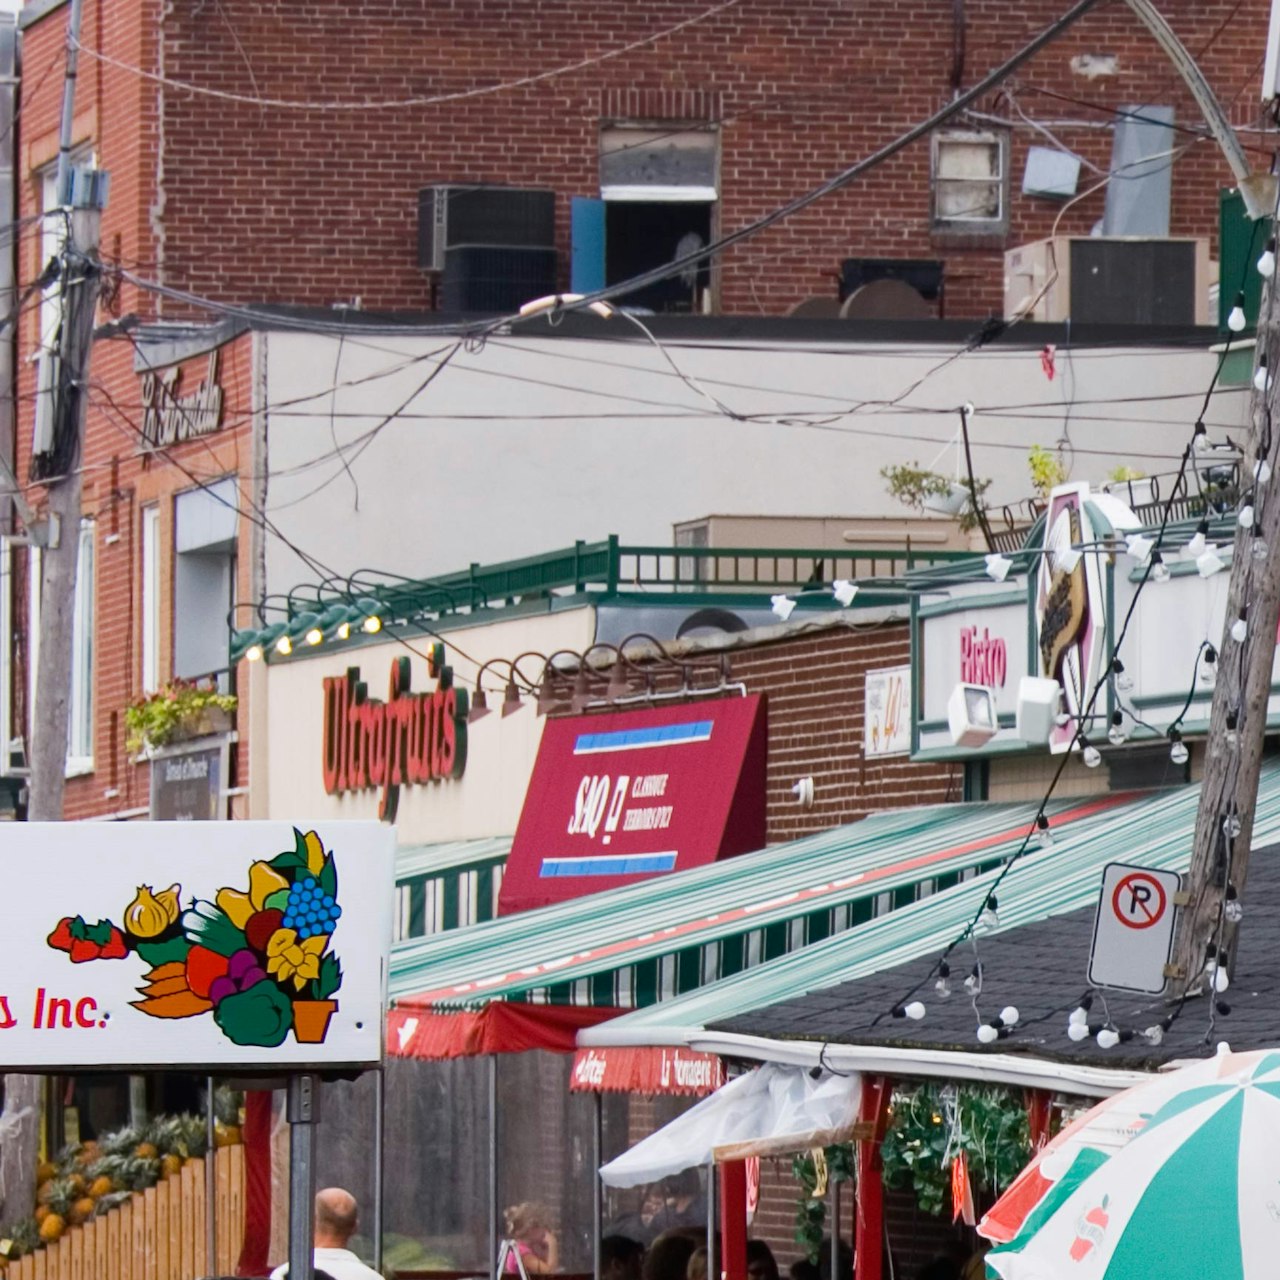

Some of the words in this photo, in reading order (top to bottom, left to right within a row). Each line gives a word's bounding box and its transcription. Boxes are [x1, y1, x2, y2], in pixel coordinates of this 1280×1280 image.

[960, 624, 1007, 689] Bistro
[322, 642, 469, 824] Ultrafruits
[567, 774, 610, 839] SAQ
[1130, 885, 1152, 914] P
[33, 987, 107, 1029] Inc.
